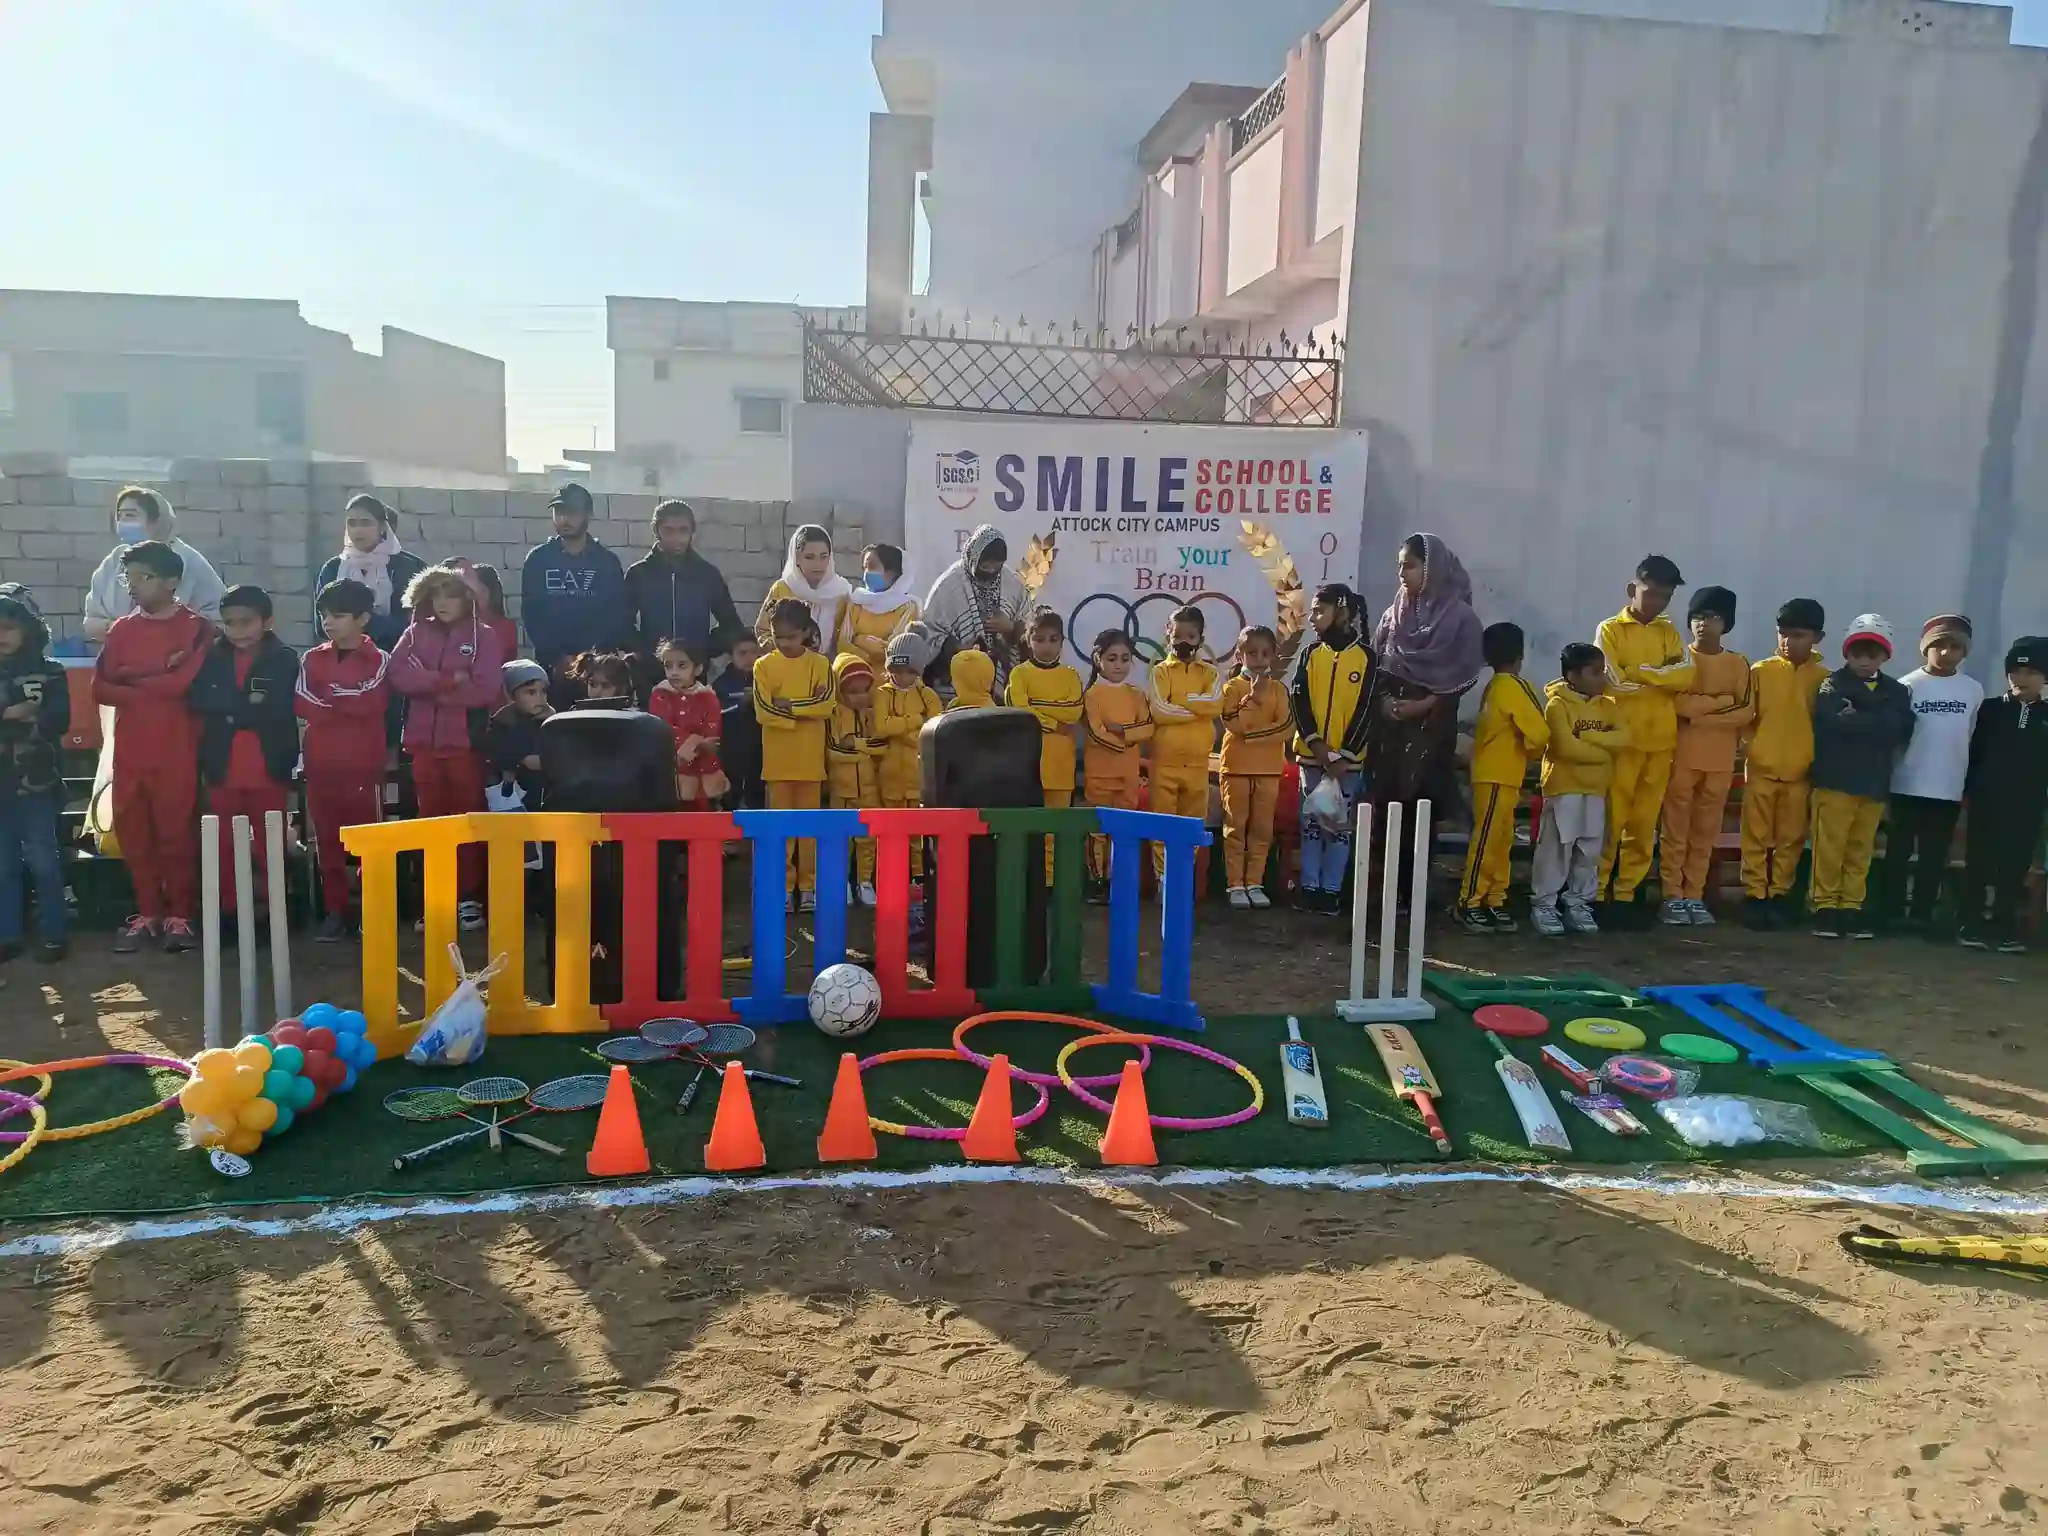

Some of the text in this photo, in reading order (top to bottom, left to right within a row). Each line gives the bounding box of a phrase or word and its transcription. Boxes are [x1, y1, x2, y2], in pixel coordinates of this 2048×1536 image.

[994, 454, 1187, 512] SMILE
[1196, 459, 1333, 485] SCHOOL &
[1195, 488, 1332, 514] COLLEGE
[1051, 517, 1220, 532] ATTOCK CITY CAMPUS
[1090, 540, 1232, 569] Train your
[545, 567, 596, 590] EA7
[1133, 567, 1206, 592] Brain
[1913, 699, 1967, 708] UNDER
